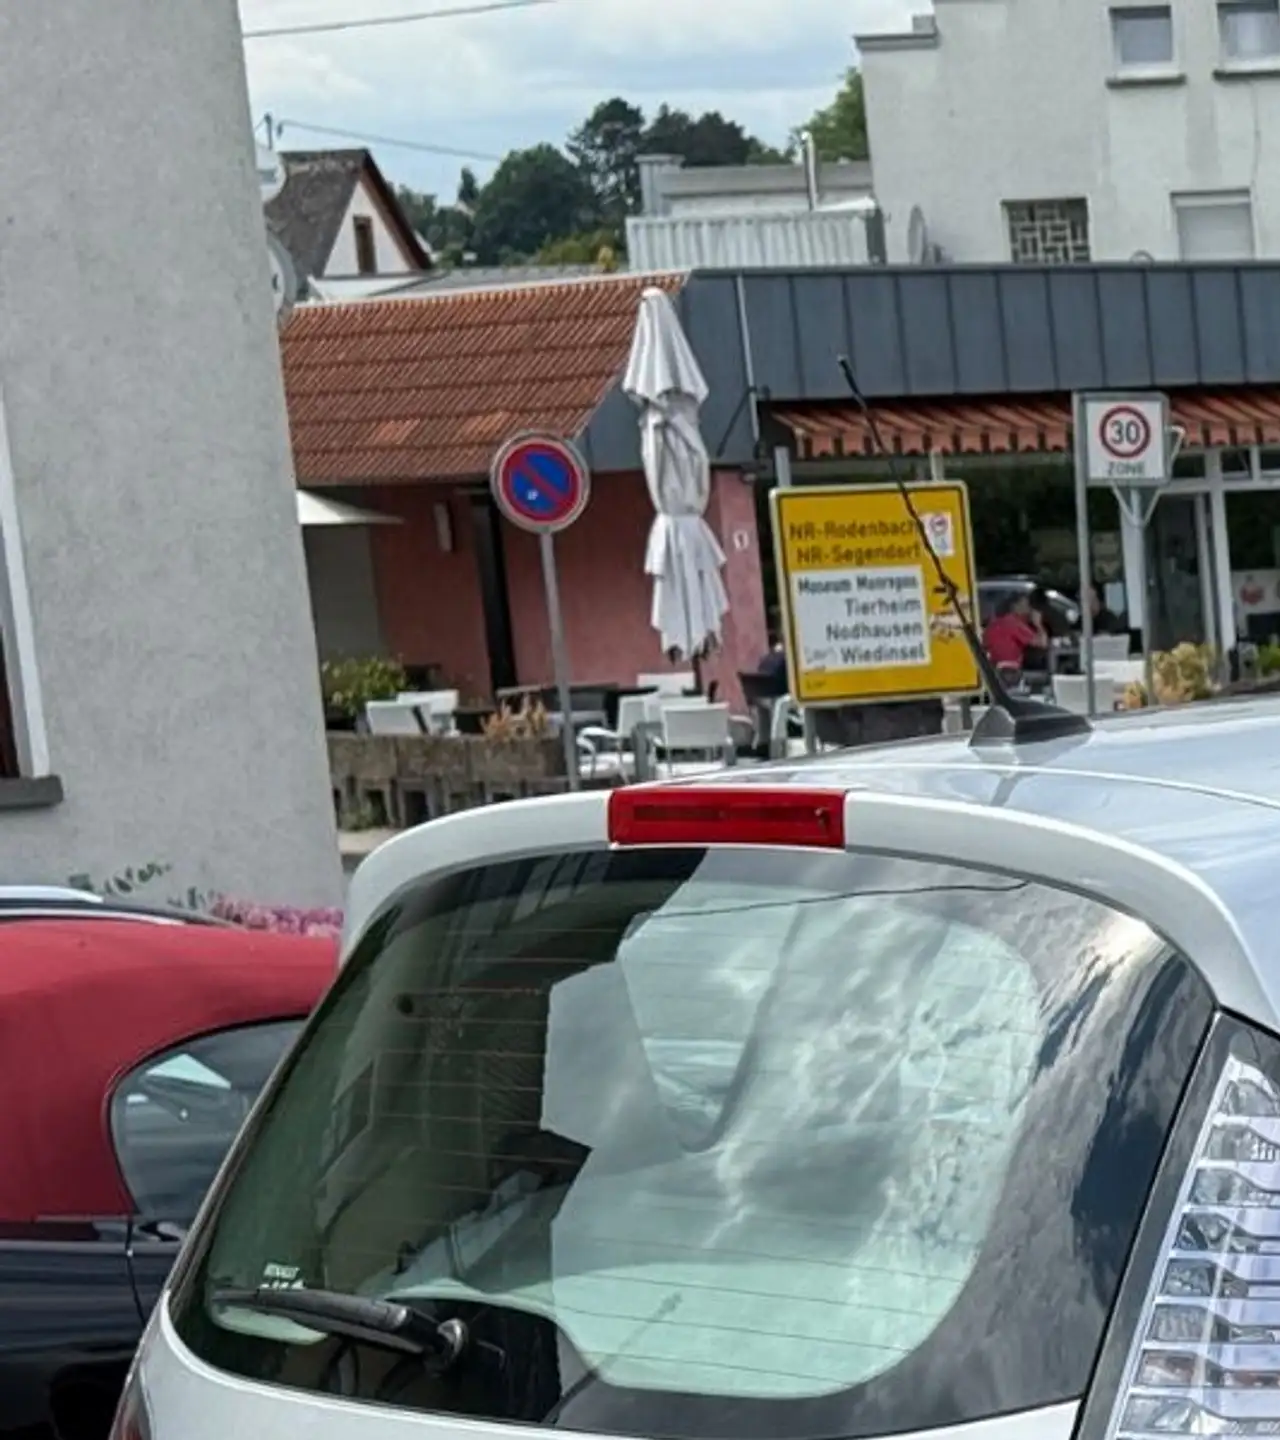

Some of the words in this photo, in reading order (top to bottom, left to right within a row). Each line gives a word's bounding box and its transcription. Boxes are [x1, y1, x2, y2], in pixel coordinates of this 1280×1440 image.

[1110, 420, 1140, 445] 30
[1107, 461, 1145, 476] ZONE
[796, 542, 921, 565] NR-Segendorf
[798, 576, 851, 594] Museum
[856, 574, 918, 592] Monrepos
[844, 598, 922, 616] Tierheim
[826, 621, 923, 642] Nodhausen
[840, 642, 925, 663] Wiedinsel
